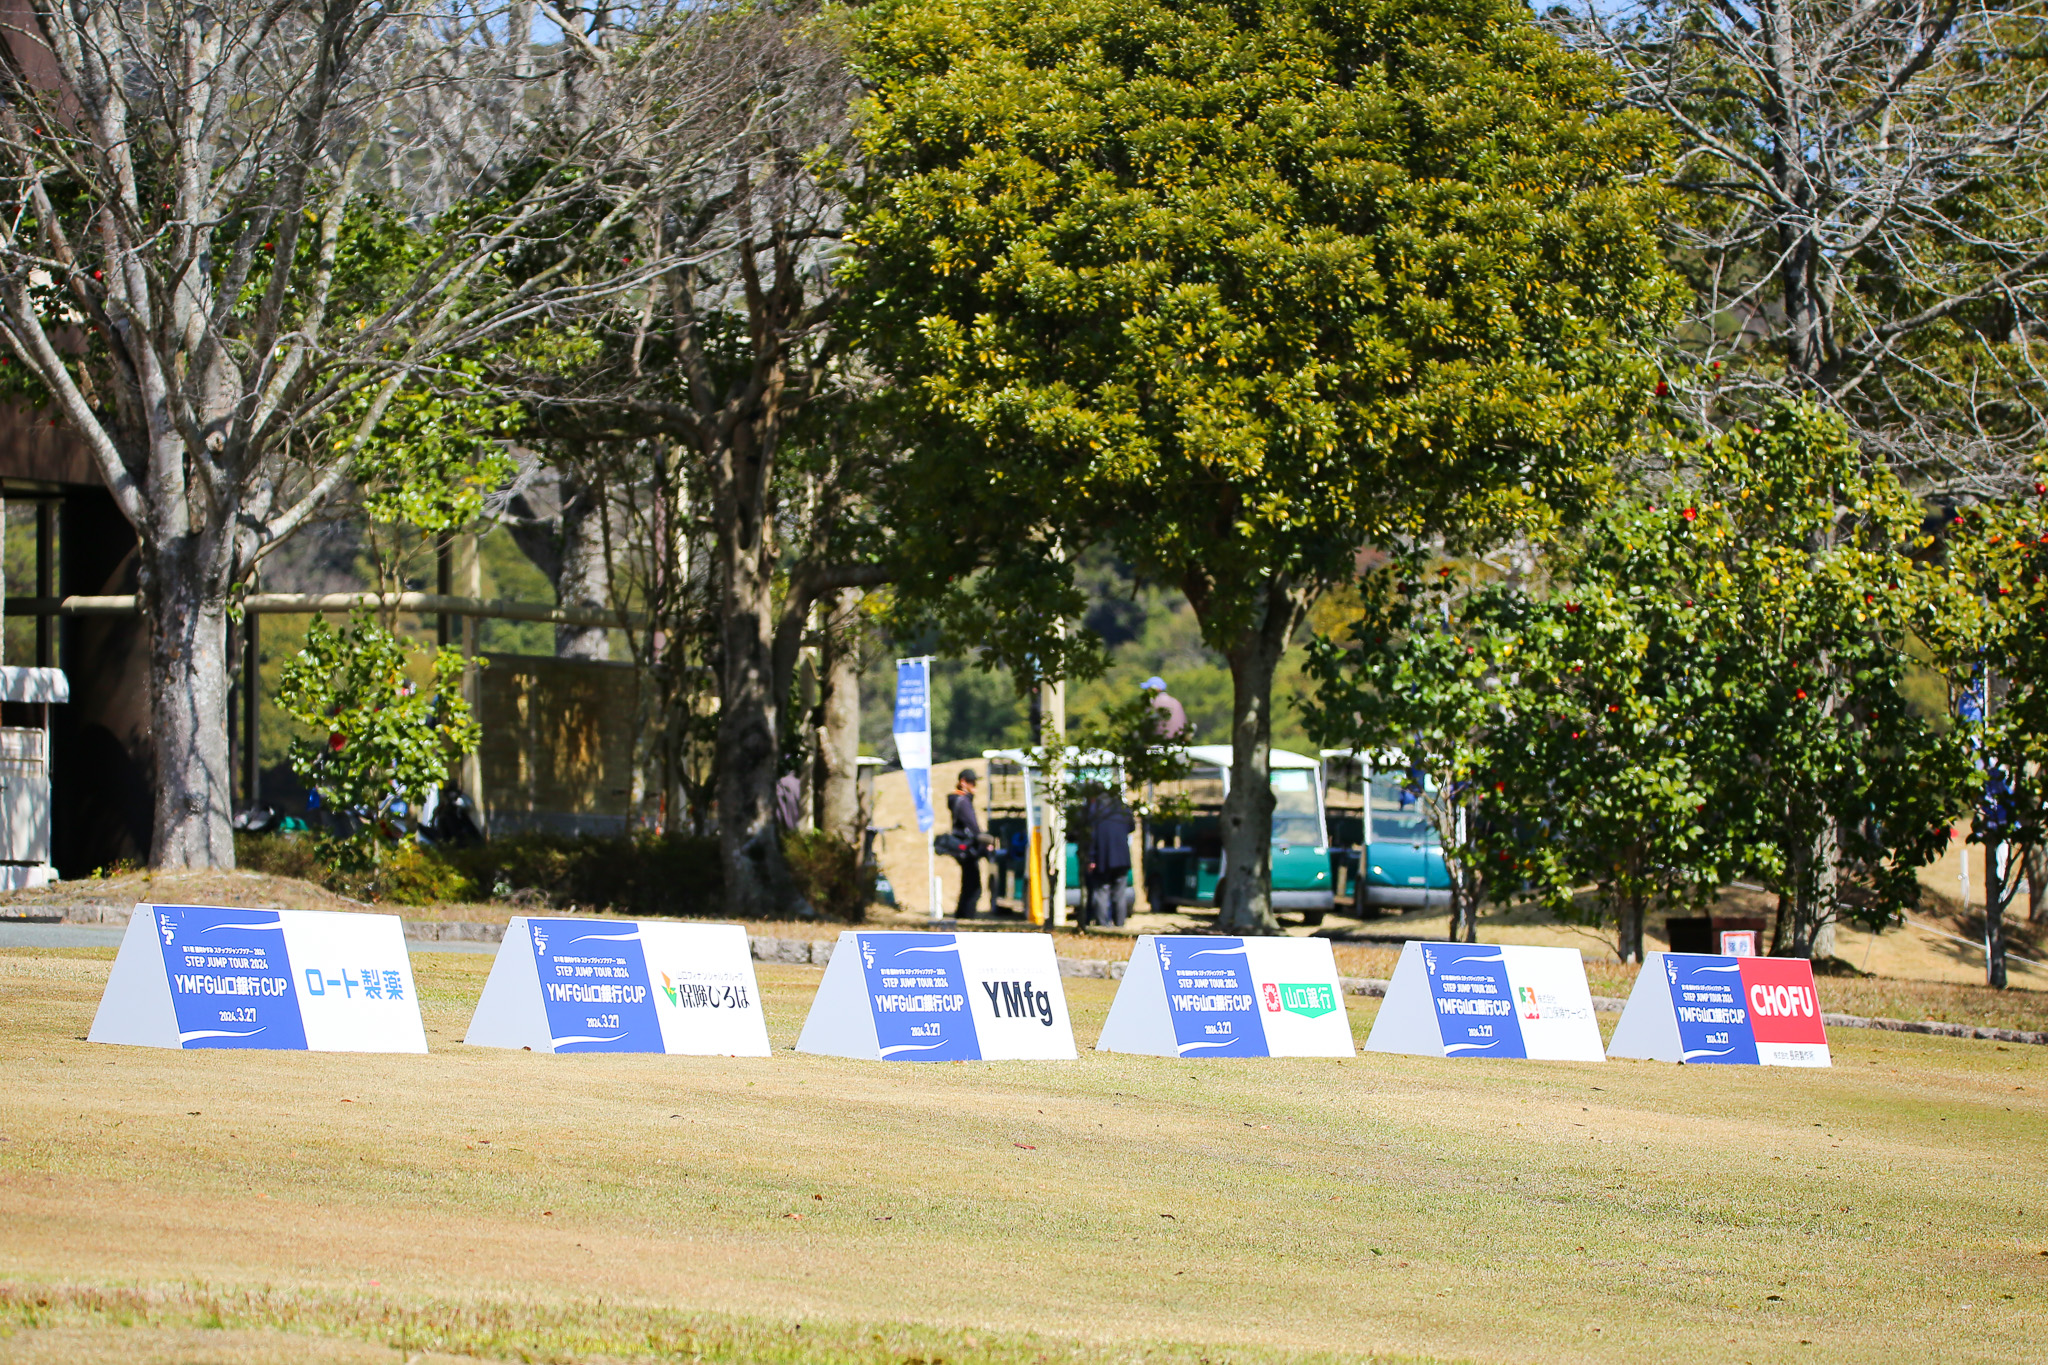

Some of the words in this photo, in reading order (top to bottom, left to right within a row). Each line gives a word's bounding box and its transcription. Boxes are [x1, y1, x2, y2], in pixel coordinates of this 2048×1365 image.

[185, 955, 206, 968] STEP
[206, 956, 228, 968] JUMP
[228, 957, 251, 970] TOUR
[250, 958, 269, 970] 2024
[555, 965, 574, 977] STEP
[575, 966, 594, 977] JUMP
[594, 967, 613, 978] TOUR
[613, 967, 630, 978] 2024
[174, 974, 288, 997] YMFG山口銀行CUP
[305, 968, 404, 1000] ロート製薬
[882, 978, 899, 988] STEP
[899, 978, 917, 988] JUMP
[916, 978, 934, 988] TOUR
[934, 978, 949, 988] 2024
[1178, 978, 1193, 988] STEP
[1194, 978, 1209, 988] JUMP
[1209, 978, 1224, 988] TOUR
[1223, 979, 1238, 988] 2024
[546, 983, 646, 1004] YMFG山口銀行CUP
[1284, 986, 1332, 1010] 山口銀行
[1750, 984, 1814, 1018] CHOFU
[981, 980, 1053, 1027] YMfg
[219, 1007, 257, 1022] 2024.3.27
[586, 1014, 619, 1028] 2024.3.27
